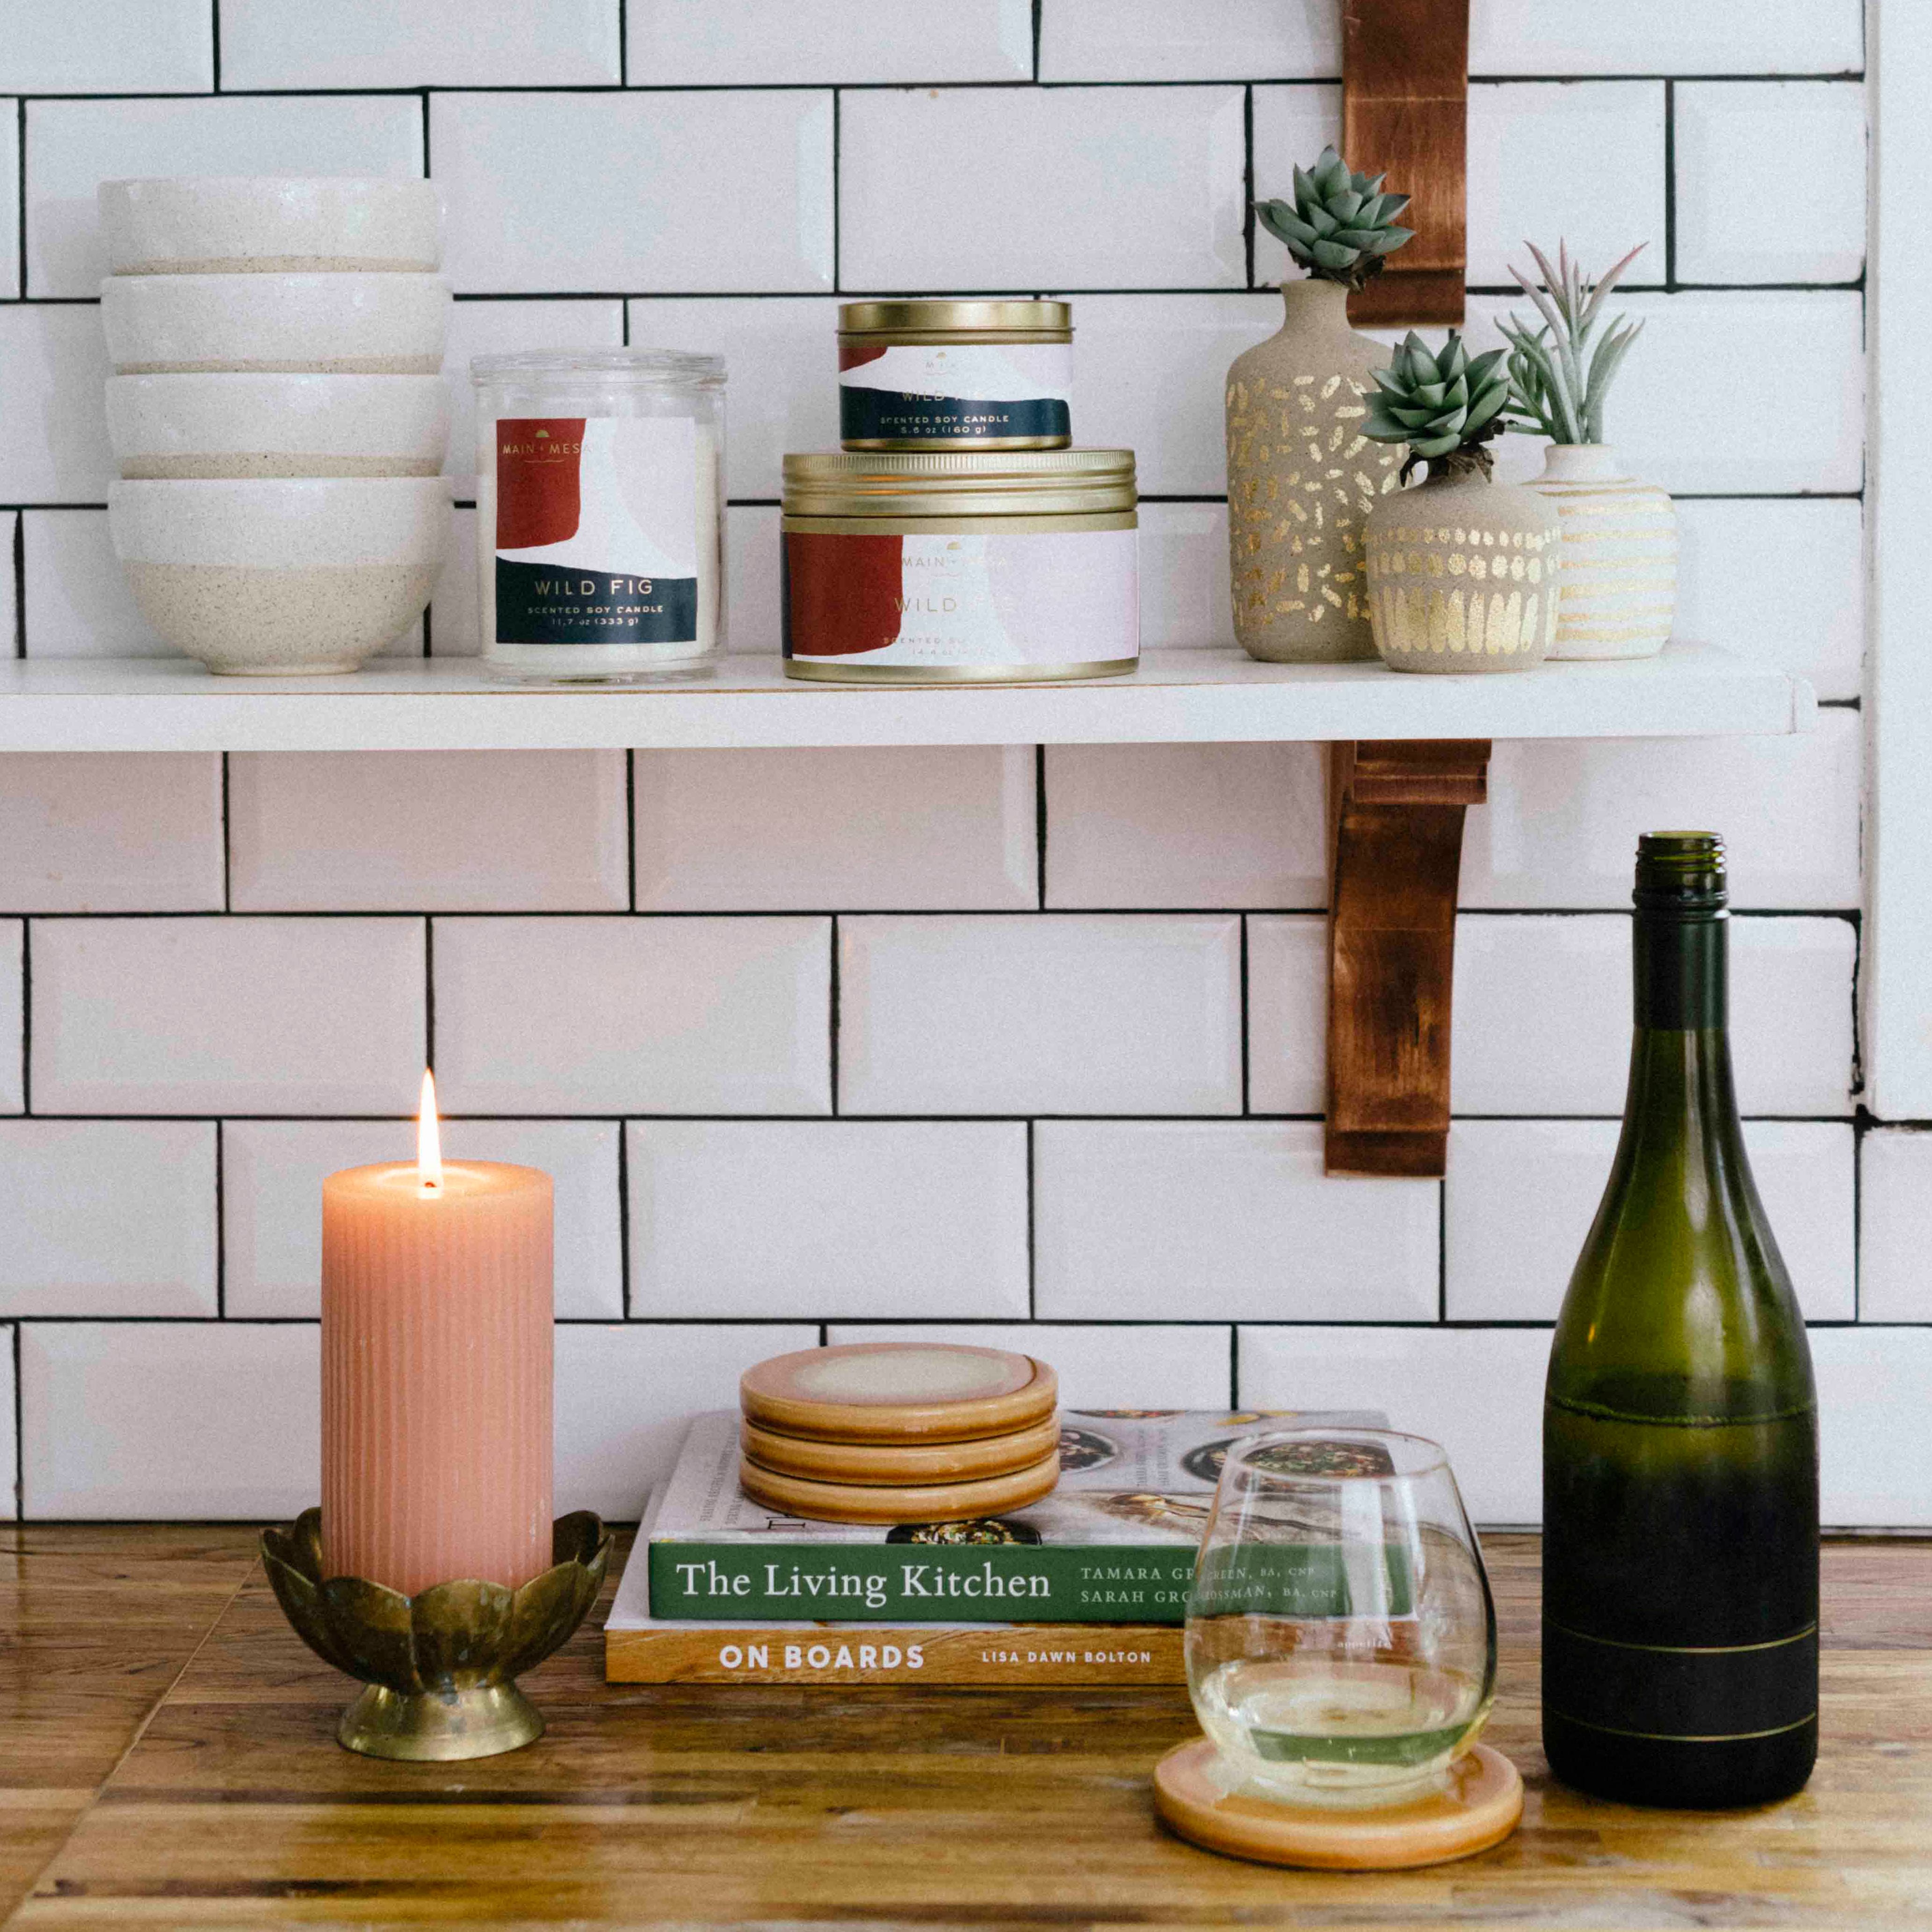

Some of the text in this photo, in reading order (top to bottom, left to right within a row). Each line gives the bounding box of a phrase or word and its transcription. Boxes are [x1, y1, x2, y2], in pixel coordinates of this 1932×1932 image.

[902, 391, 945, 402] WILD
[963, 415, 1009, 423] CANDLE
[941, 426, 970, 434] (160
[975, 426, 986, 434] g)
[502, 444, 535, 455] MAIN
[902, 557, 945, 567] MAIN
[535, 579, 653, 595] WILD FIG
[616, 605, 664, 614] CANDLE
[894, 597, 957, 612] WILD
[594, 617, 624, 625] (333
[628, 617, 639, 626] g)
[1080, 1568, 1162, 1579] TAMARA
[676, 1561, 1051, 1608] The Living Kitchen
[1080, 1591, 1144, 1602] SARAH
[719, 1644, 924, 1669] ON BOARDS
[982, 1651, 1151, 1662] LISA DAWN BOLTON
